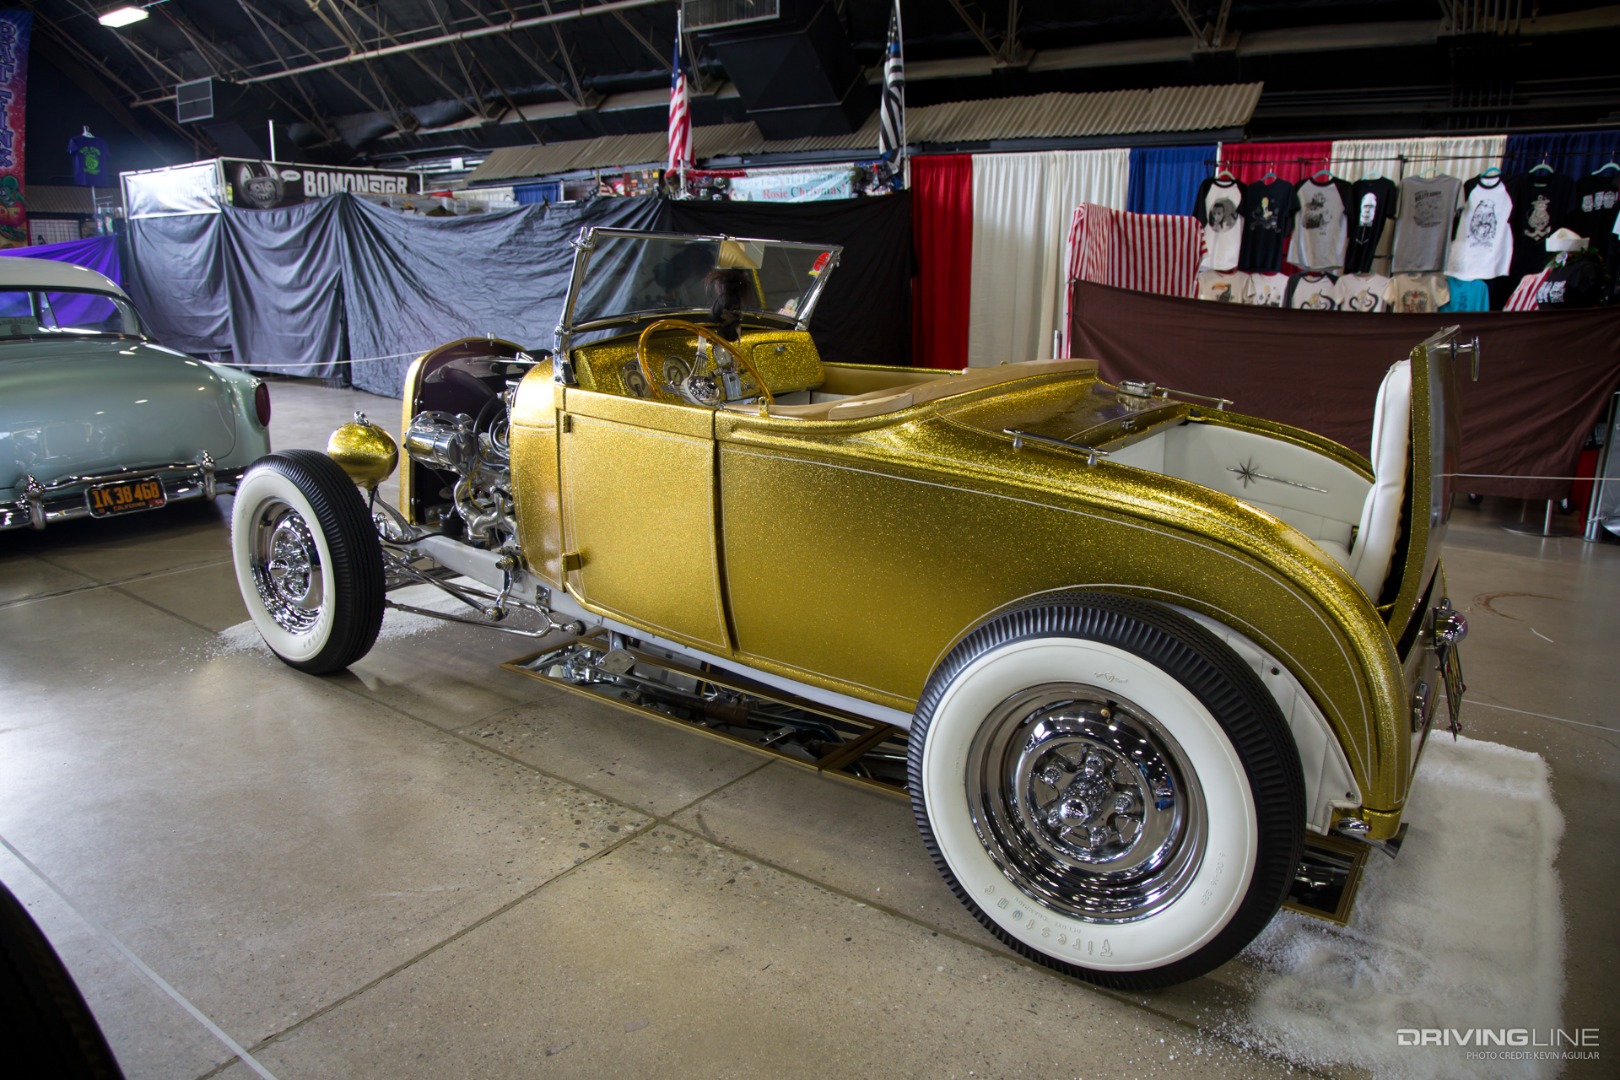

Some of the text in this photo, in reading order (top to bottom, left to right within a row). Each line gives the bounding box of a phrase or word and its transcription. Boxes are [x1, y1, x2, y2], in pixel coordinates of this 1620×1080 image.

[763, 183, 846, 199] Rosie Christmas!
[134, 481, 160, 501] 468
[984, 884, 1113, 958] Firestone
